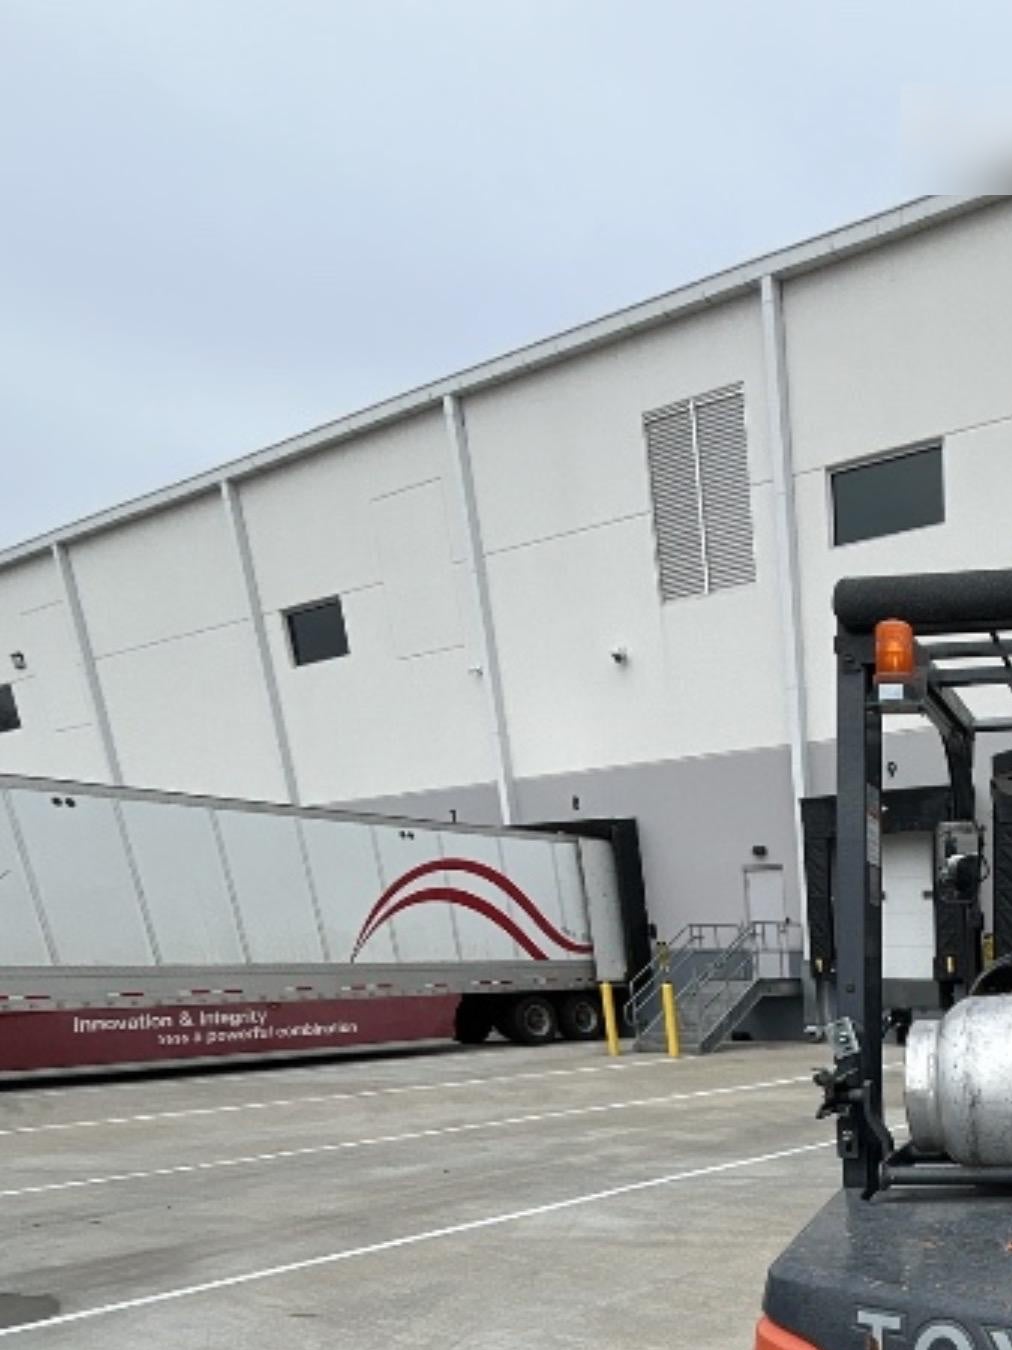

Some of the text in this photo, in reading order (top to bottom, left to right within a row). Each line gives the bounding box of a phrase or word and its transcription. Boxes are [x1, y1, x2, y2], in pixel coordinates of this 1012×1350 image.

[73, 1009, 268, 1033] Innovation & Integrity
